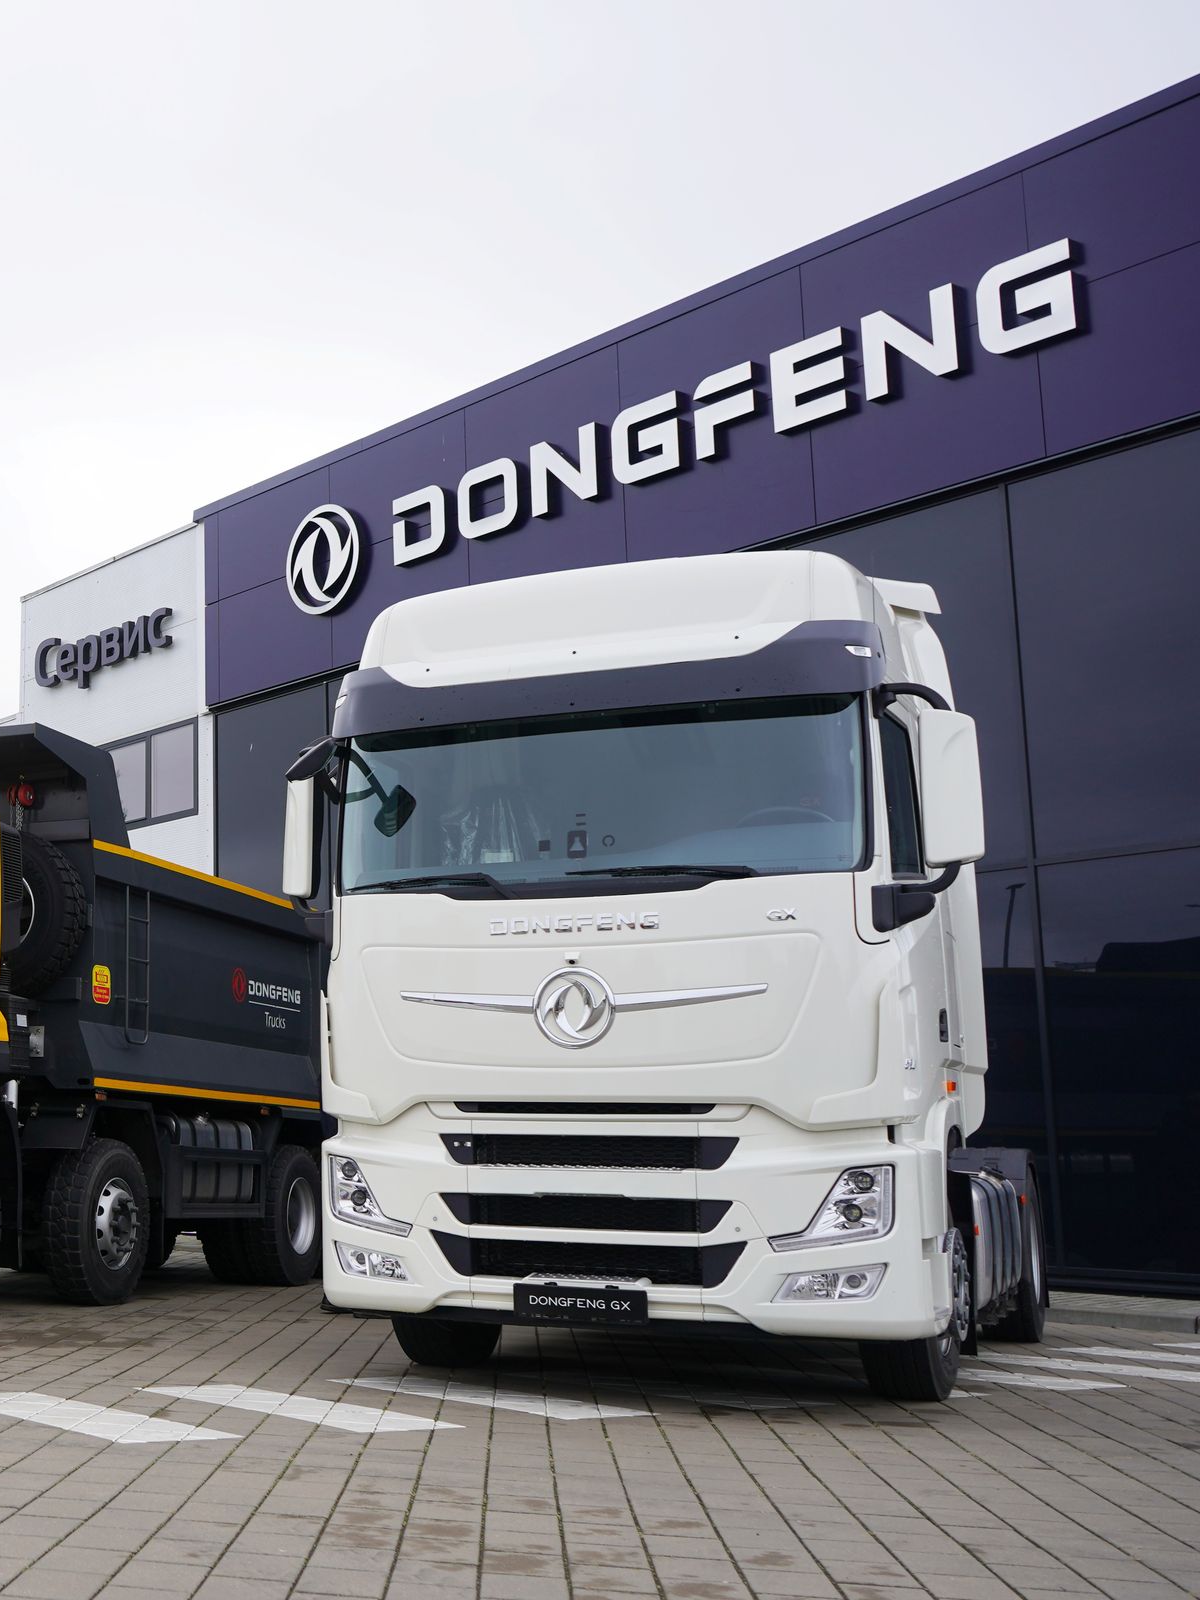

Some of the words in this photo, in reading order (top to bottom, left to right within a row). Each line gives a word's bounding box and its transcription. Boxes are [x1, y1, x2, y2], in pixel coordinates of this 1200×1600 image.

[392, 238, 1081, 567] DONGFENG
[35, 607, 173, 689] Сервис
[489, 911, 660, 936] DONGFENG
[765, 907, 797, 921] GX
[248, 979, 301, 1005] DONGFENG
[264, 1011, 286, 1029] Trucks
[528, 1294, 606, 1310] DONGFENG
[610, 1300, 631, 1312] GX
